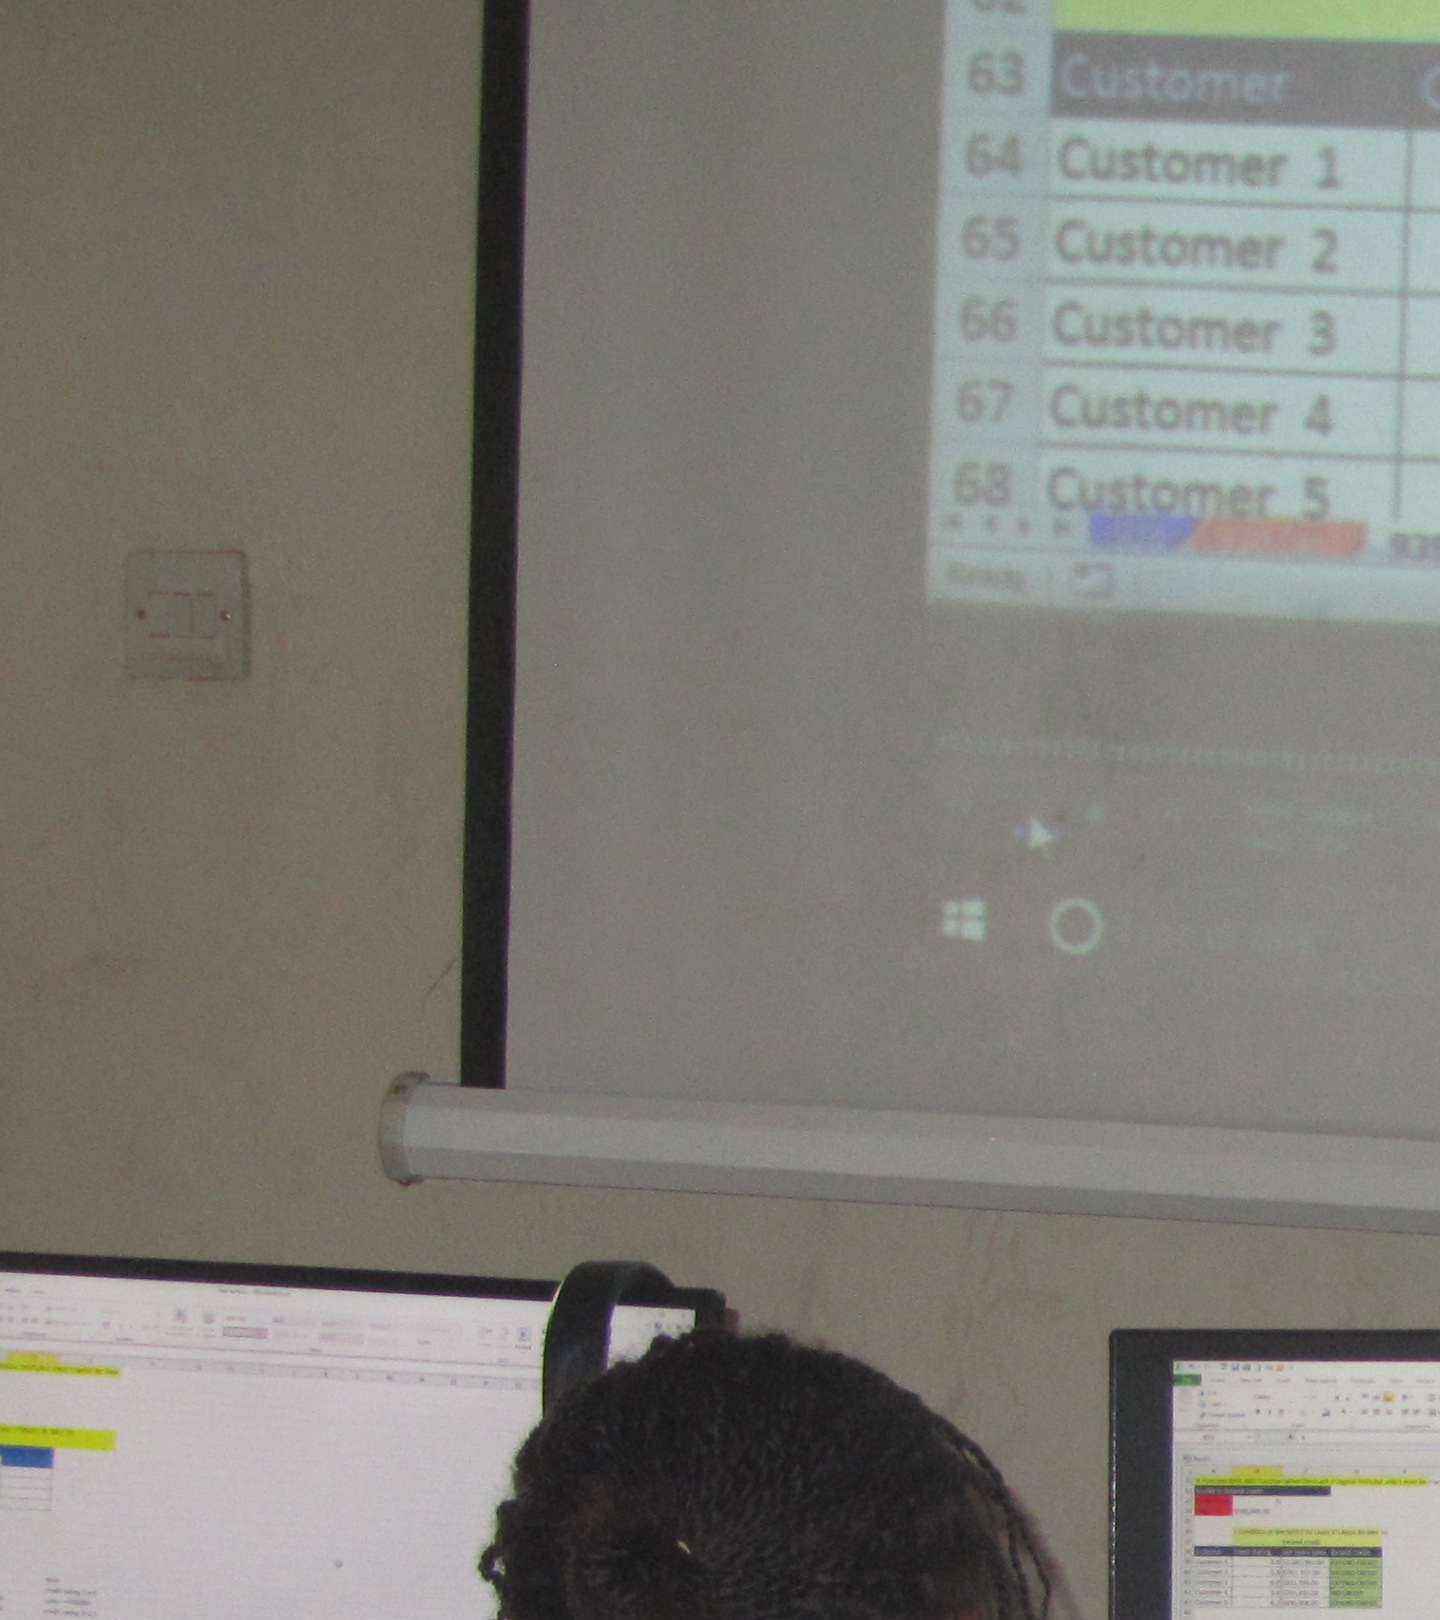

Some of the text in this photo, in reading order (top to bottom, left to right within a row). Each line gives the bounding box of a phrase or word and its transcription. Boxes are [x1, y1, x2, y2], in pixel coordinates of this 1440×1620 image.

[966, 52, 1025, 97] 63
[1060, 53, 1289, 105] Customer
[964, 134, 1025, 177] 64
[1058, 134, 1342, 191] Customer 1
[961, 216, 1020, 260] 65
[1055, 217, 1340, 273] Customer 2
[959, 299, 1019, 342] 66
[1052, 300, 1338, 356] Customer 3
[956, 381, 1016, 425] 67
[1048, 383, 1334, 439] Customer 4
[953, 462, 1012, 506] 68
[1045, 467, 1330, 522] Customer 5
